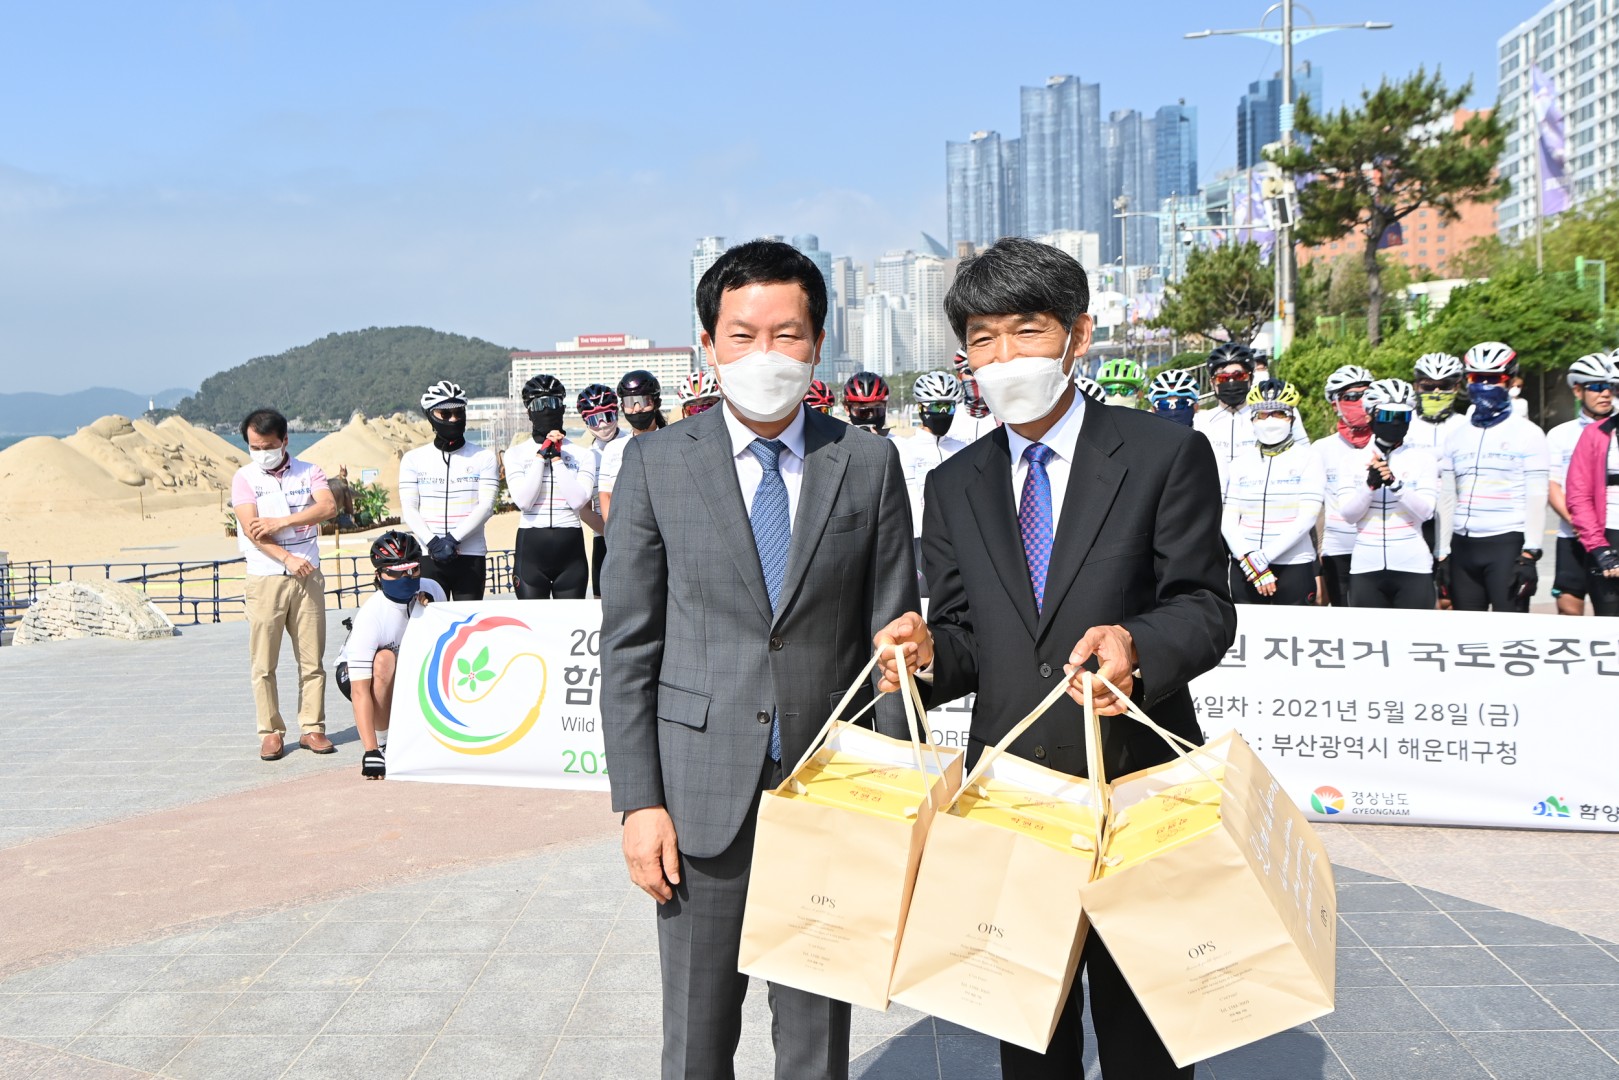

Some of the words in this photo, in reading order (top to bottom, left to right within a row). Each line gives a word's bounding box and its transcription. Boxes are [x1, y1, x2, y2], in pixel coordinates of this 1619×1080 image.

[1263, 635, 1390, 669] 자전거
[1272, 698, 1358, 723] 2021년
[1367, 700, 1405, 725] 5월
[1414, 702, 1468, 726] 28일
[1478, 702, 1520, 728] (금)
[561, 716, 595, 733] Wild
[1271, 734, 1388, 760] 부산광역시
[1397, 737, 1518, 766] 해운대구청
[1351, 791, 1409, 806] 경상남도
[1351, 807, 1410, 816] GYEONGNAM
[1579, 803, 1619, 823] 함양
[811, 894, 836, 909] OPS
[977, 922, 1004, 939] OPS
[1188, 940, 1217, 960] OPS
